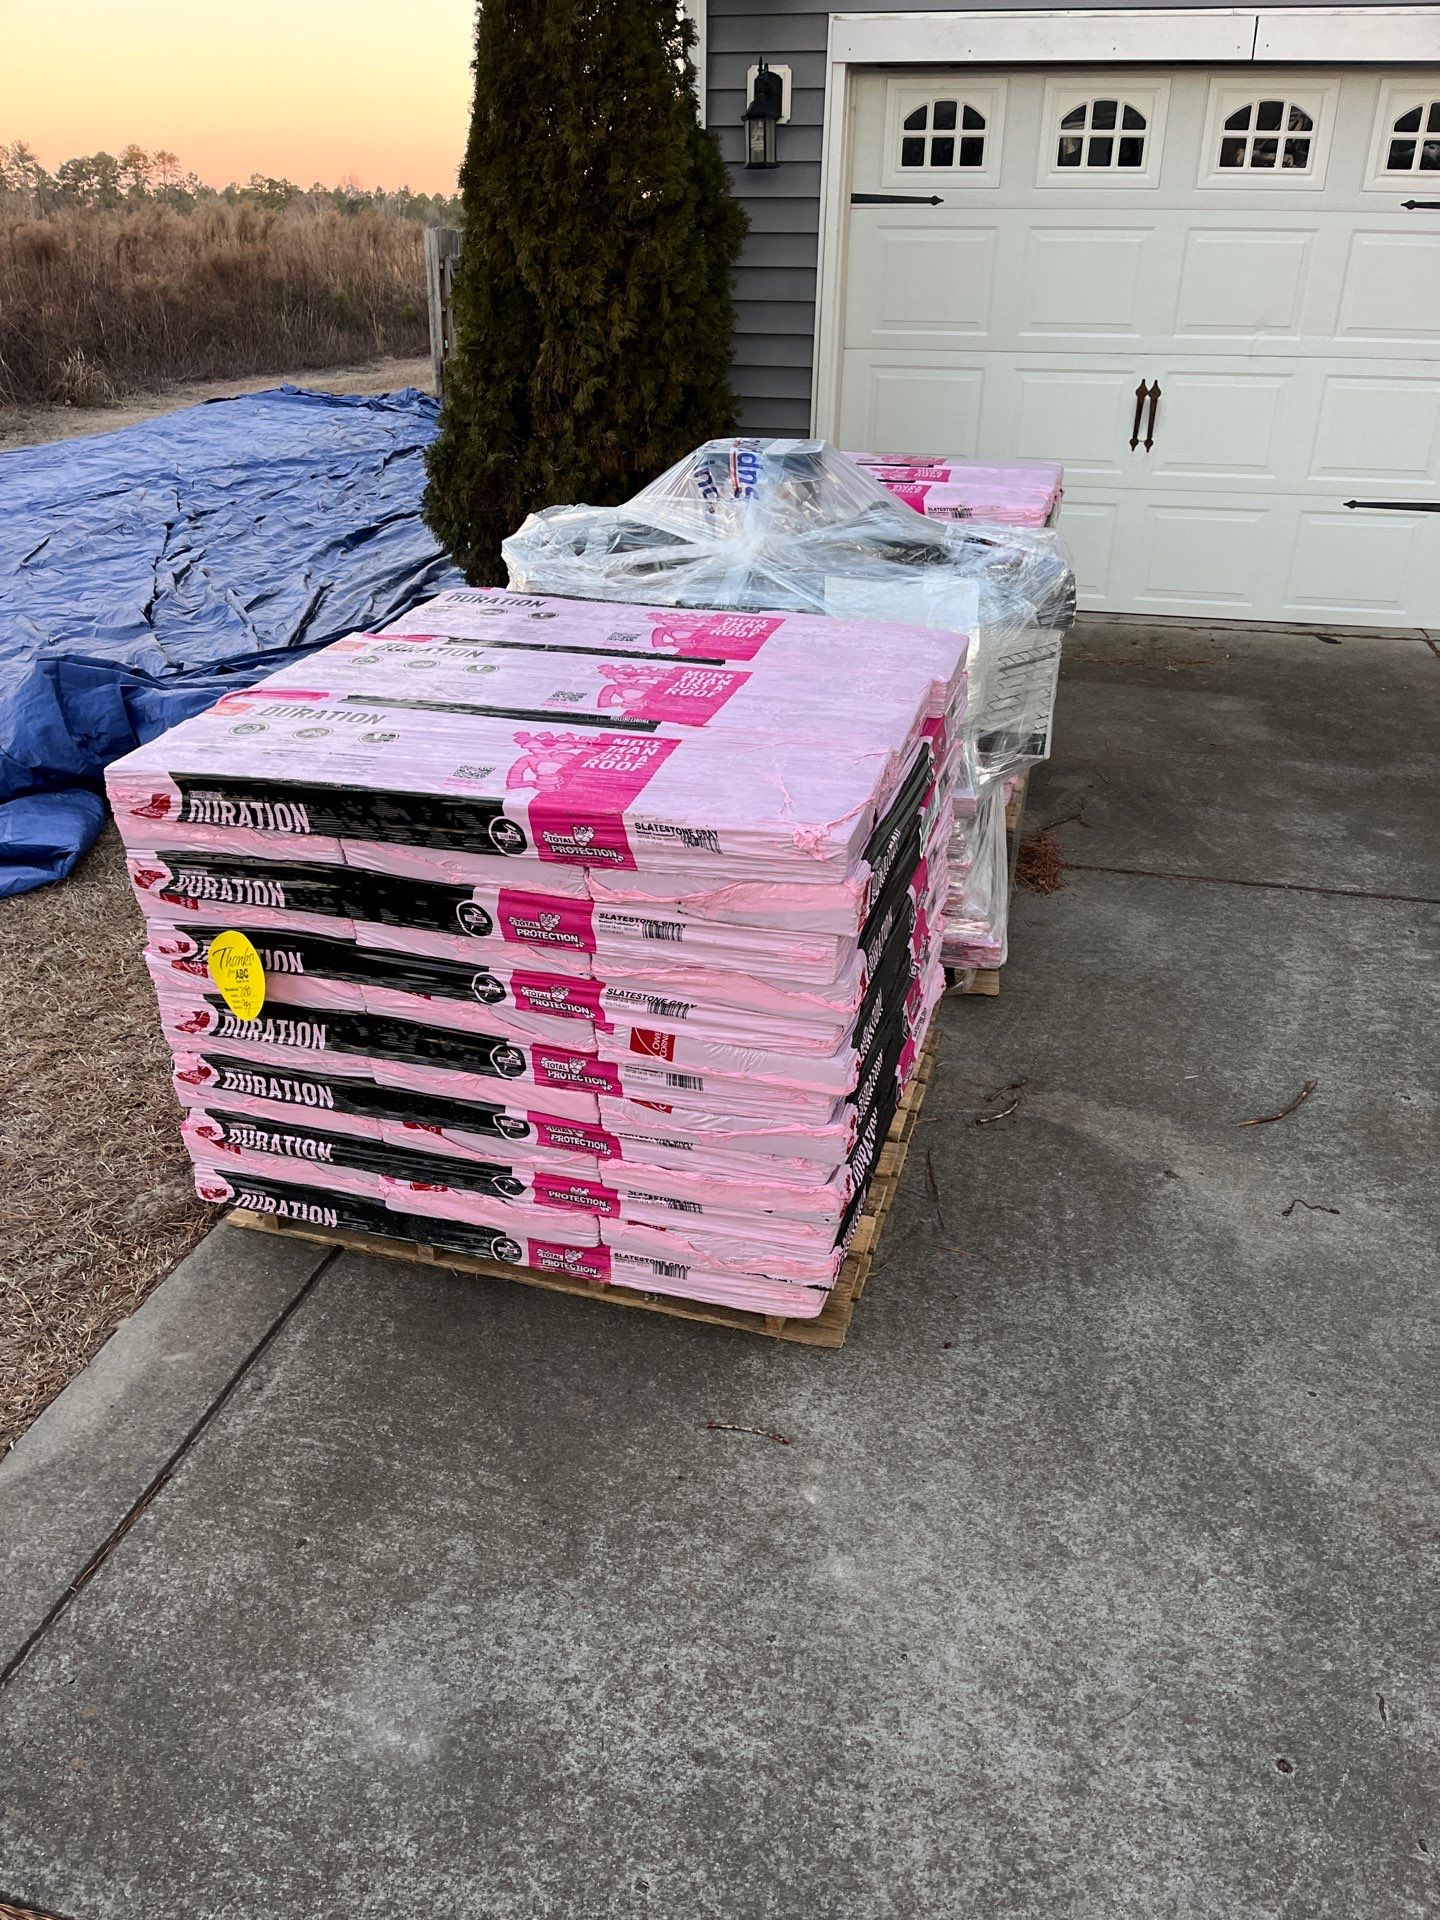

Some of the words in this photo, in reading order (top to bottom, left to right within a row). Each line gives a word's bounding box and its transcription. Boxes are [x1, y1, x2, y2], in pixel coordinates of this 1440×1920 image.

[446, 594, 547, 608] DURATION
[709, 629, 757, 638] ROOF
[664, 687, 719, 698] ROOF
[671, 681, 710, 690] JUST
[256, 706, 387, 725] DURATION
[581, 760, 645, 771] ROOF
[187, 799, 311, 834] DURATION
[635, 822, 693, 838] SLATESTONE
[696, 829, 719, 839] GRAY
[548, 836, 573, 845] TOTAL
[551, 845, 617, 857] PROTECTION
[170, 874, 286, 908] DURATION
[515, 919, 540, 928] TOTAL
[598, 912, 659, 927] SLATESTONE
[516, 928, 579, 943] PROTECTION
[212, 947, 254, 970] Thanks
[235, 969, 249, 979] ABC
[527, 990, 549, 999] TOTAL
[607, 988, 668, 1004] SLATESTONE
[530, 998, 590, 1015] PROTECTION
[218, 1015, 326, 1050] DURATION
[546, 1061, 567, 1071] TOTAL
[548, 1070, 608, 1086] PROTECTION
[222, 1072, 335, 1109] DURATION
[228, 1128, 334, 1163] DURATION
[551, 1133, 608, 1150] PROTECTION
[548, 1190, 607, 1207] PROTECTION
[234, 1194, 338, 1228] DURATION
[541, 1252, 563, 1261] TOTAL
[614, 1252, 667, 1267] SLATESTONE
[668, 1261, 692, 1270] GRAY
[542, 1259, 598, 1274] PROTECTION
